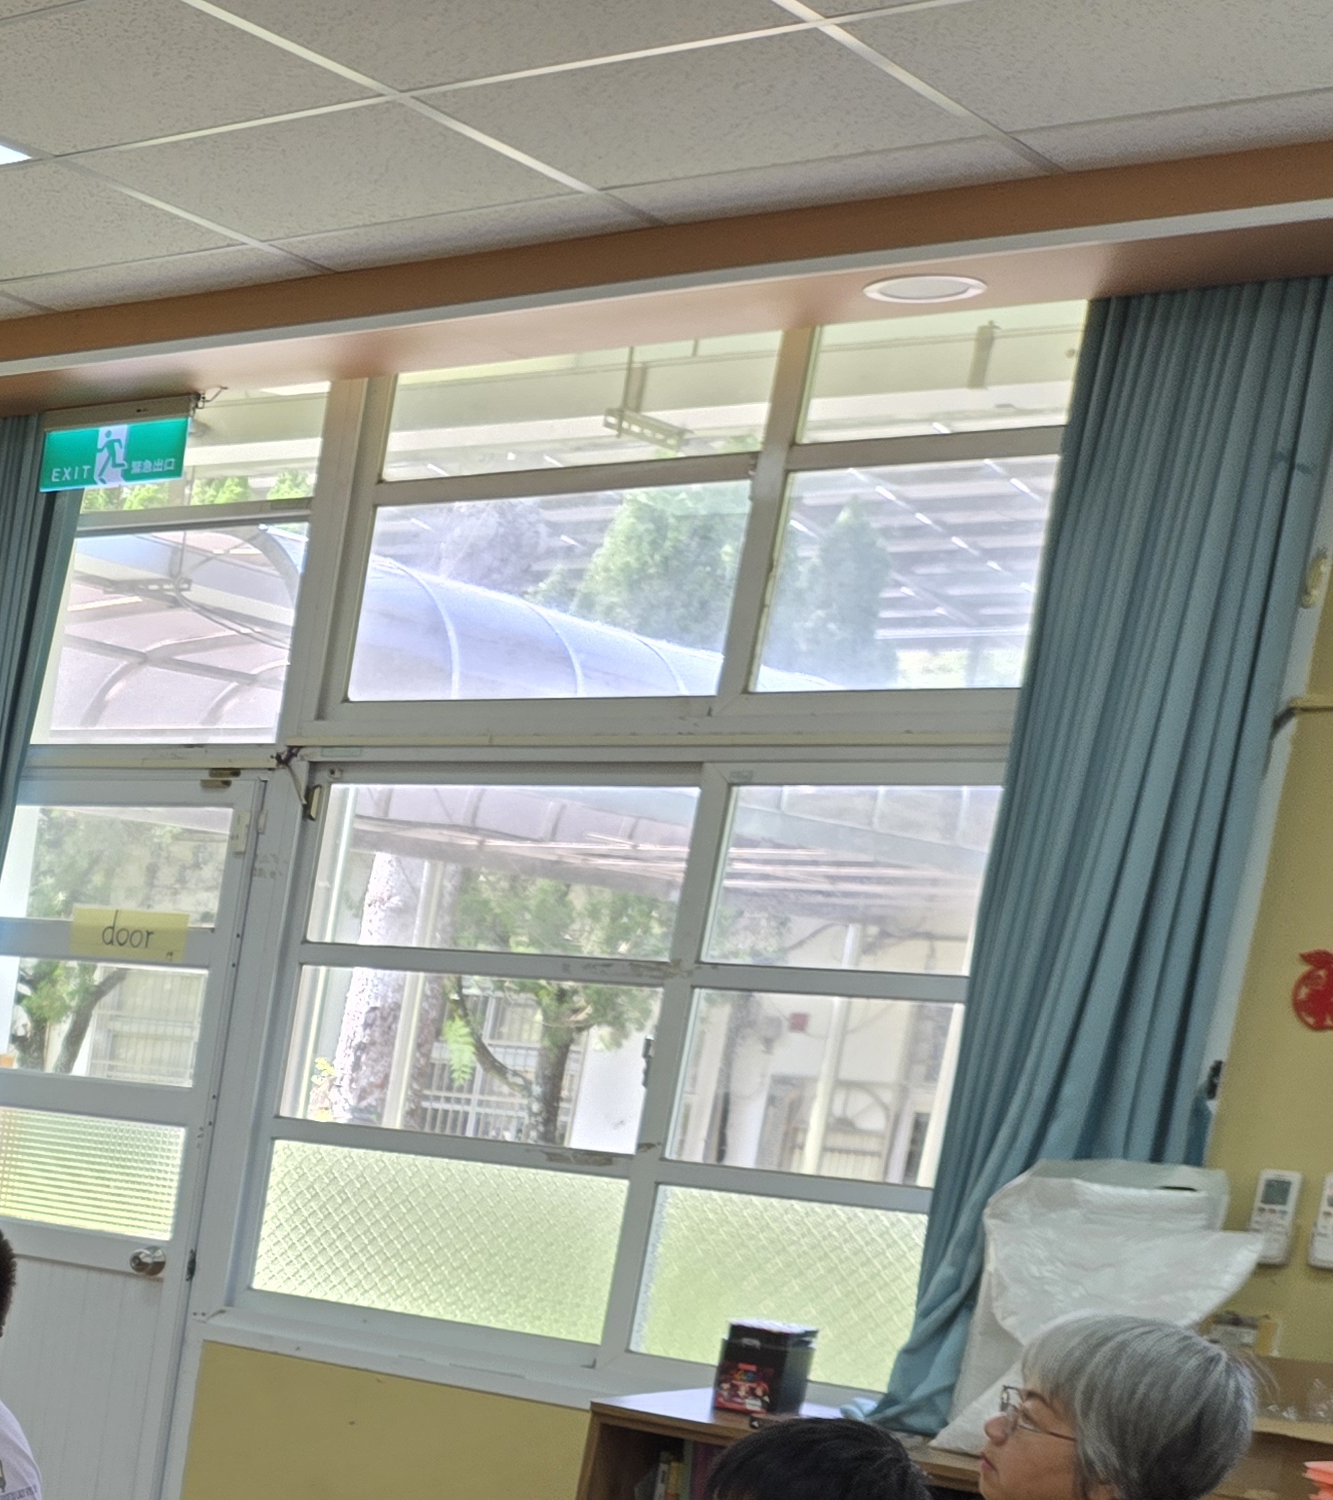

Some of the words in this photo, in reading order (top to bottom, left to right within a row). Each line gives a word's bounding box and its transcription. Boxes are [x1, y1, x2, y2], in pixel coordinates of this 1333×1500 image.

[51, 465, 91, 482] EXIT
[131, 458, 175, 474] 緊急出口
[102, 909, 154, 948] door
